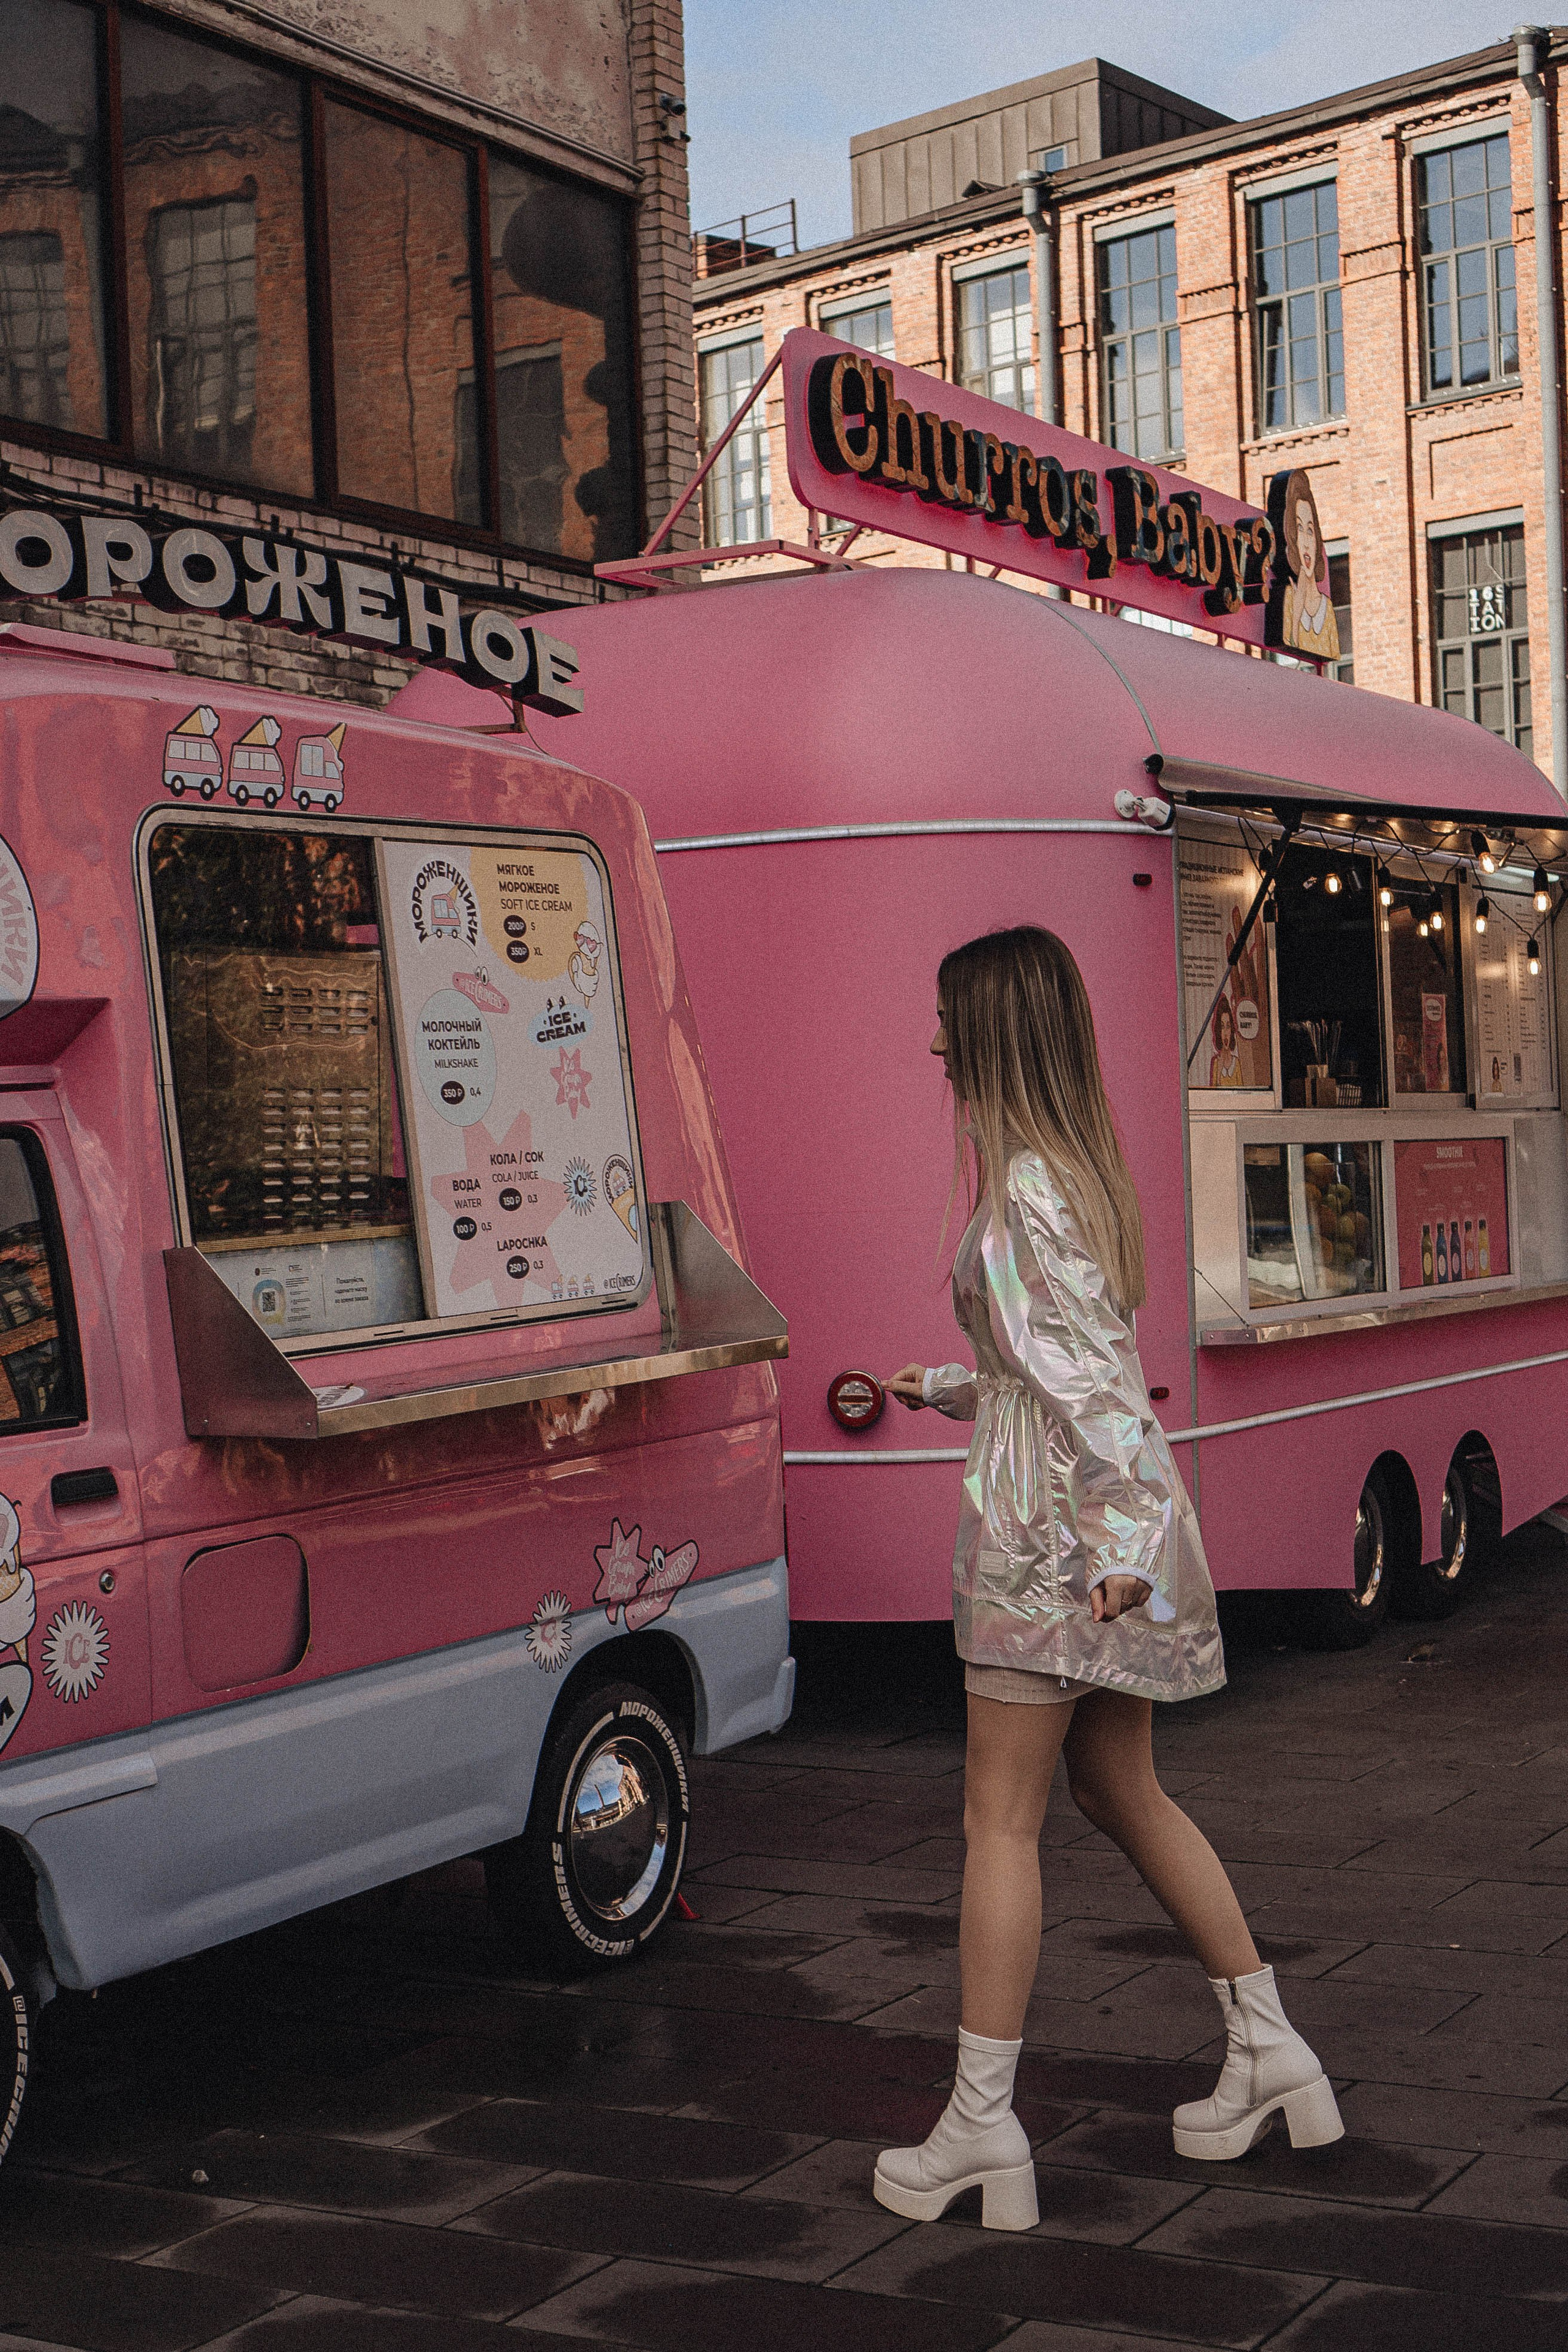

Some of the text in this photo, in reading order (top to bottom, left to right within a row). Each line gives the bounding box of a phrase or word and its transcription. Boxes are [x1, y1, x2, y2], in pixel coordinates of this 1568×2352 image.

[1107, 466, 1276, 615] Baby?
[497, 864, 535, 876] МЯГКОЕ
[499, 881, 560, 895] МОРОЖЕНОЕ
[412, 860, 478, 946] МОРОЖЕНЩИКИ
[501, 898, 573, 911] SOFT ICE CREAM
[530, 921, 536, 931] S
[533, 946, 543, 956] XL
[421, 1017, 482, 1033] МОЛОЧНЫЙ
[548, 1011, 571, 1027] ICE
[536, 1021, 586, 1043] CREAM
[428, 1035, 481, 1050] КОКТЕЙЛЬ
[434, 1058, 479, 1069] MILKSHAKE
[443, 1088, 457, 1098] 350
[490, 1153, 518, 1166] КОЛА
[525, 1151, 545, 1163] СОК
[492, 1172, 513, 1183] COLA
[518, 1170, 539, 1182] JUICE
[452, 1178, 482, 1193] ВОДА
[454, 1197, 482, 1209] WATER
[502, 1196, 514, 1206] 150
[456, 1224, 469, 1234] 100
[497, 1235, 548, 1252] LAPOCHKA
[508, 1262, 521, 1273] 250
